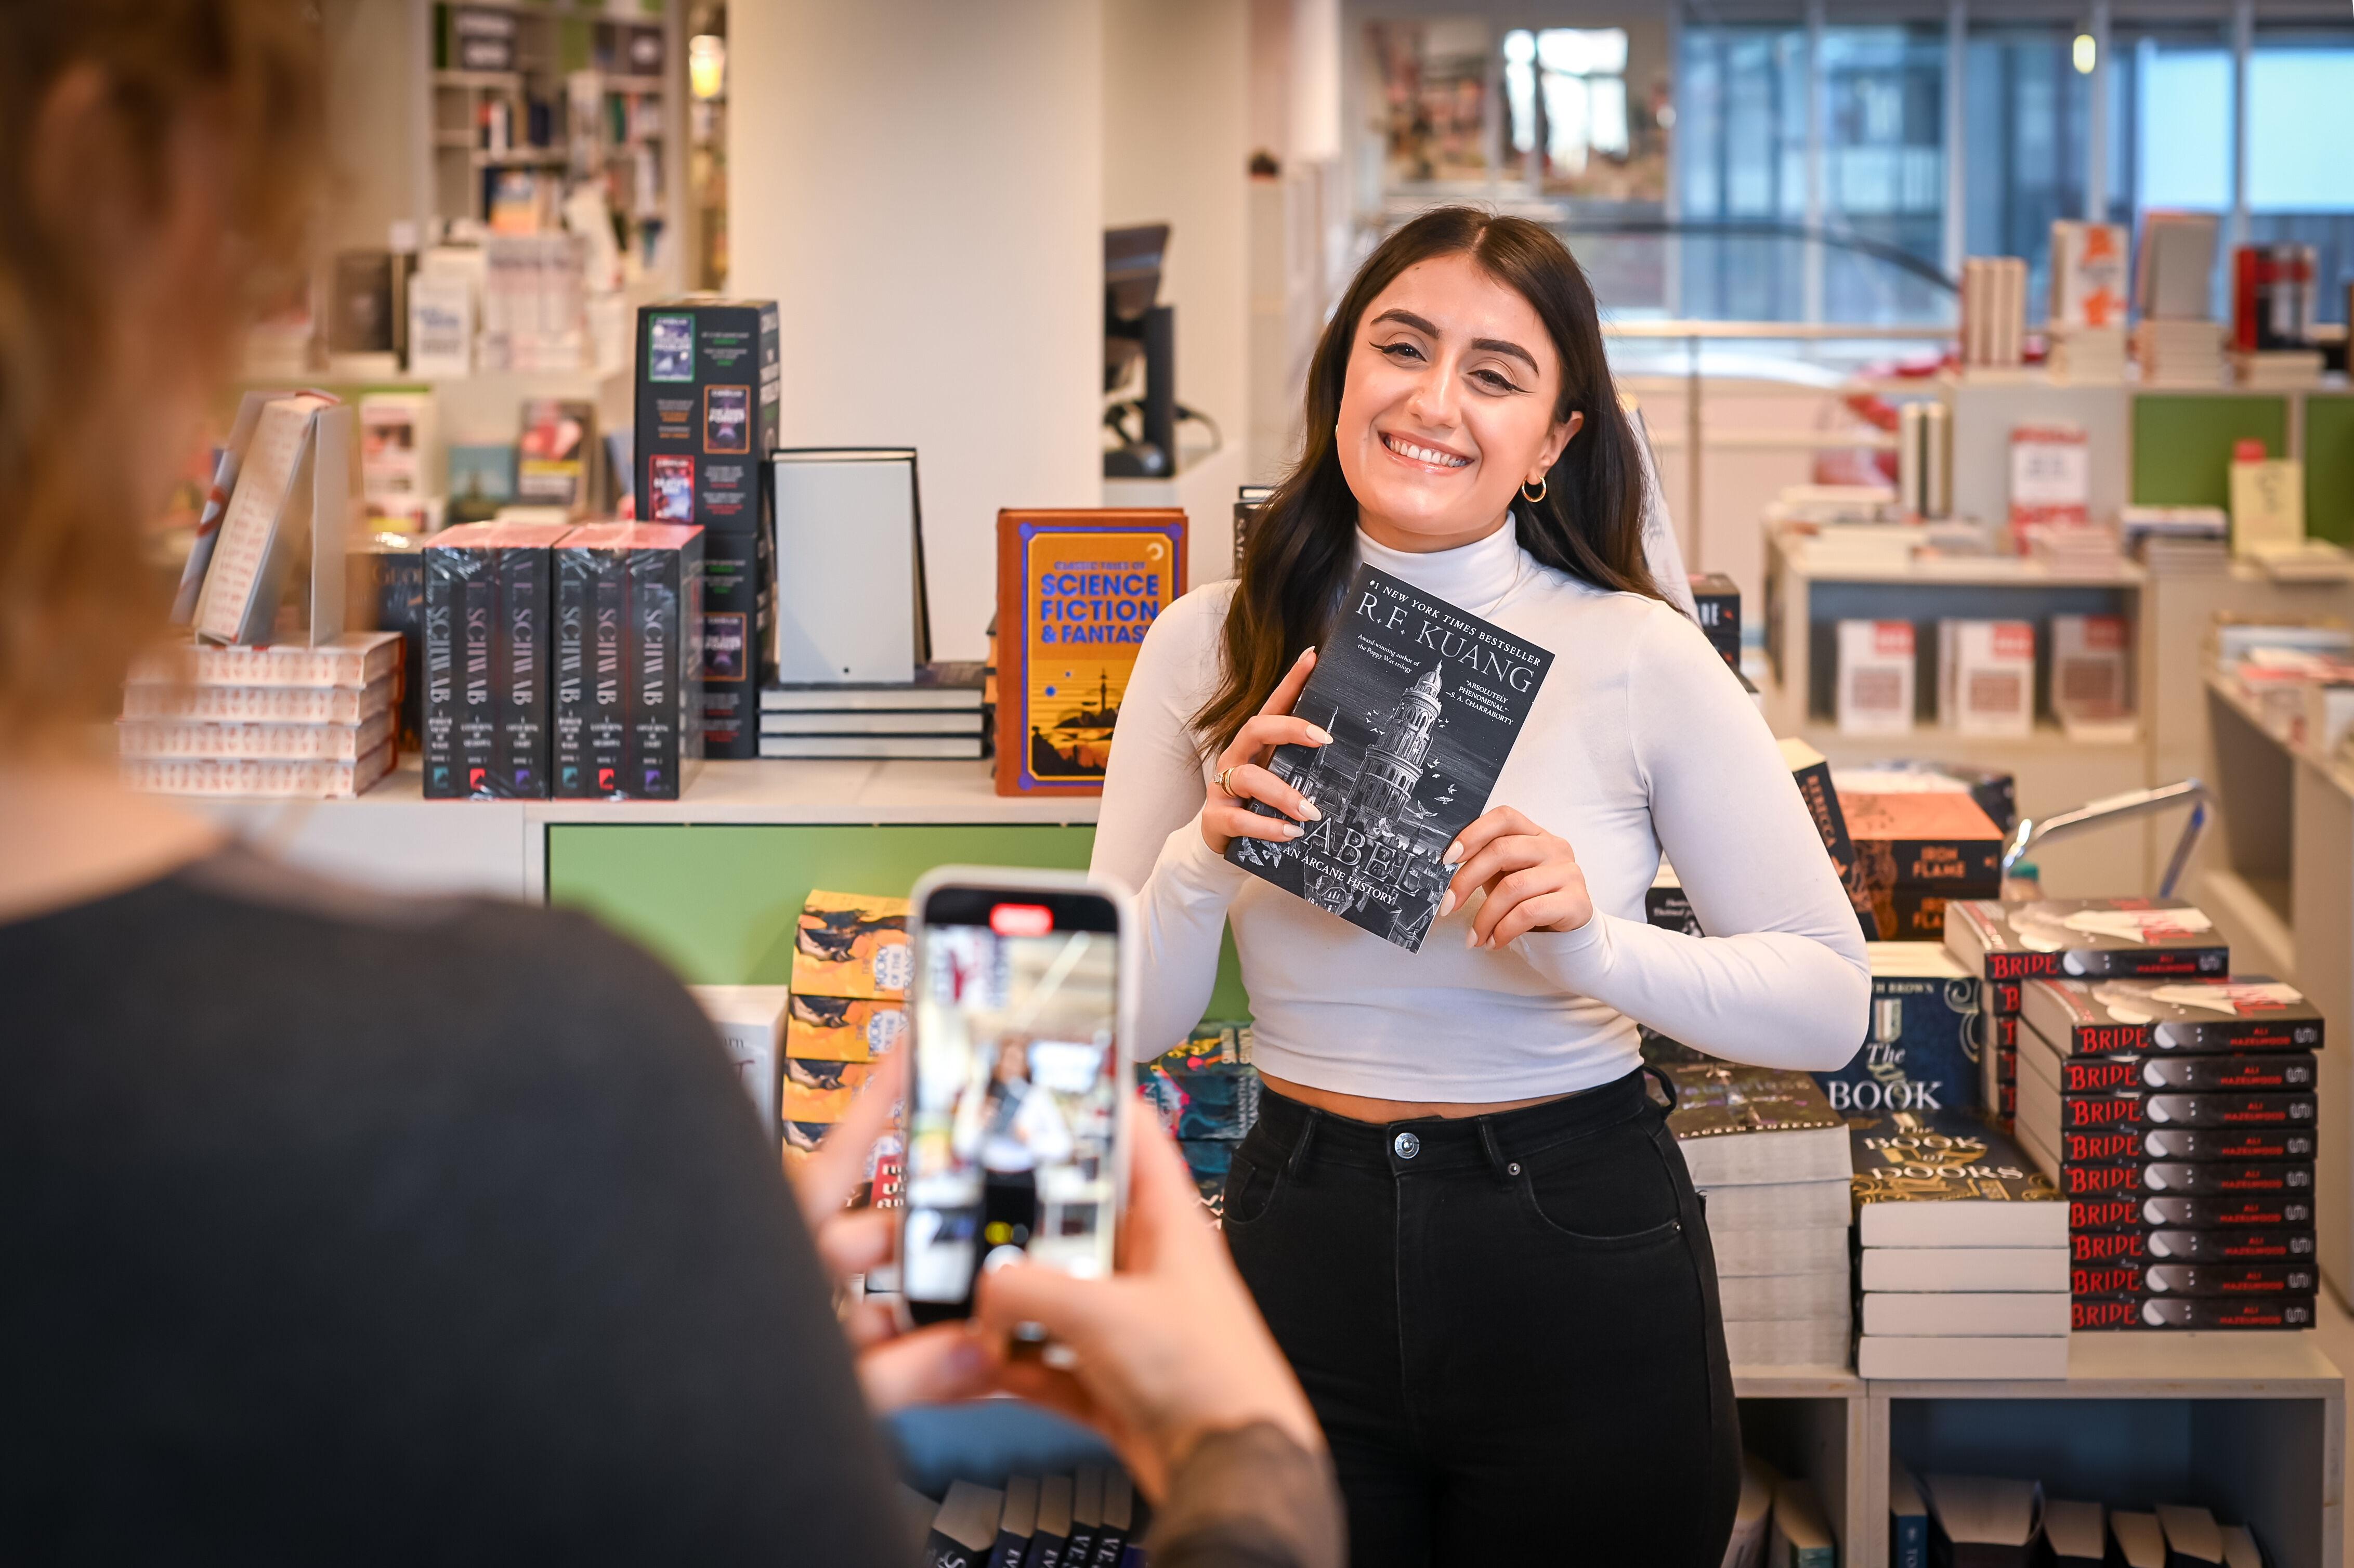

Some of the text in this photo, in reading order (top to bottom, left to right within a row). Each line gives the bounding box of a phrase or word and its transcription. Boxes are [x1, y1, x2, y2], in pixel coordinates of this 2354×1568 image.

[1041, 573, 1159, 596] SCIENCE
[1041, 599, 1159, 622] FICTION
[1369, 579, 1541, 668] #1 NEW YORK TIMES BESTSELLER
[1062, 625, 1150, 644] FANTAS
[1357, 634, 1396, 657] Award-winning
[1396, 652, 1413, 664] author
[1366, 647, 1383, 660] Poppy
[1383, 655, 1395, 664] War
[1395, 662, 1413, 674] trilogy
[1415, 619, 1535, 693] KUANG
[1465, 699, 1514, 725] CHAKRABORTY
[1300, 817, 1419, 897] ABEL
[1912, 859, 1967, 879] FLAME
[1282, 846, 1396, 906] AN ARCANE HISTORY
[1989, 954, 2058, 978] BRIDE
[2077, 1026, 2149, 1053] BRIDE
[1865, 1043, 1905, 1064] The
[2065, 1065, 2138, 1090] BRIDE
[1828, 1080, 1943, 1110] BOOK
[2068, 1100, 2141, 1126] BRIDE
[1864, 1135, 1987, 1151] BOOK
[2067, 1134, 2139, 1160] BRIDE
[1872, 1165, 2024, 1180] DOORS
[2065, 1167, 2138, 1193] BRIDE
[2070, 1201, 2138, 1228] BRIDE
[2071, 1234, 2143, 1260] BRIDE
[2071, 1269, 2141, 1295] BRIDE
[2072, 1302, 2137, 1328] BRIDE
